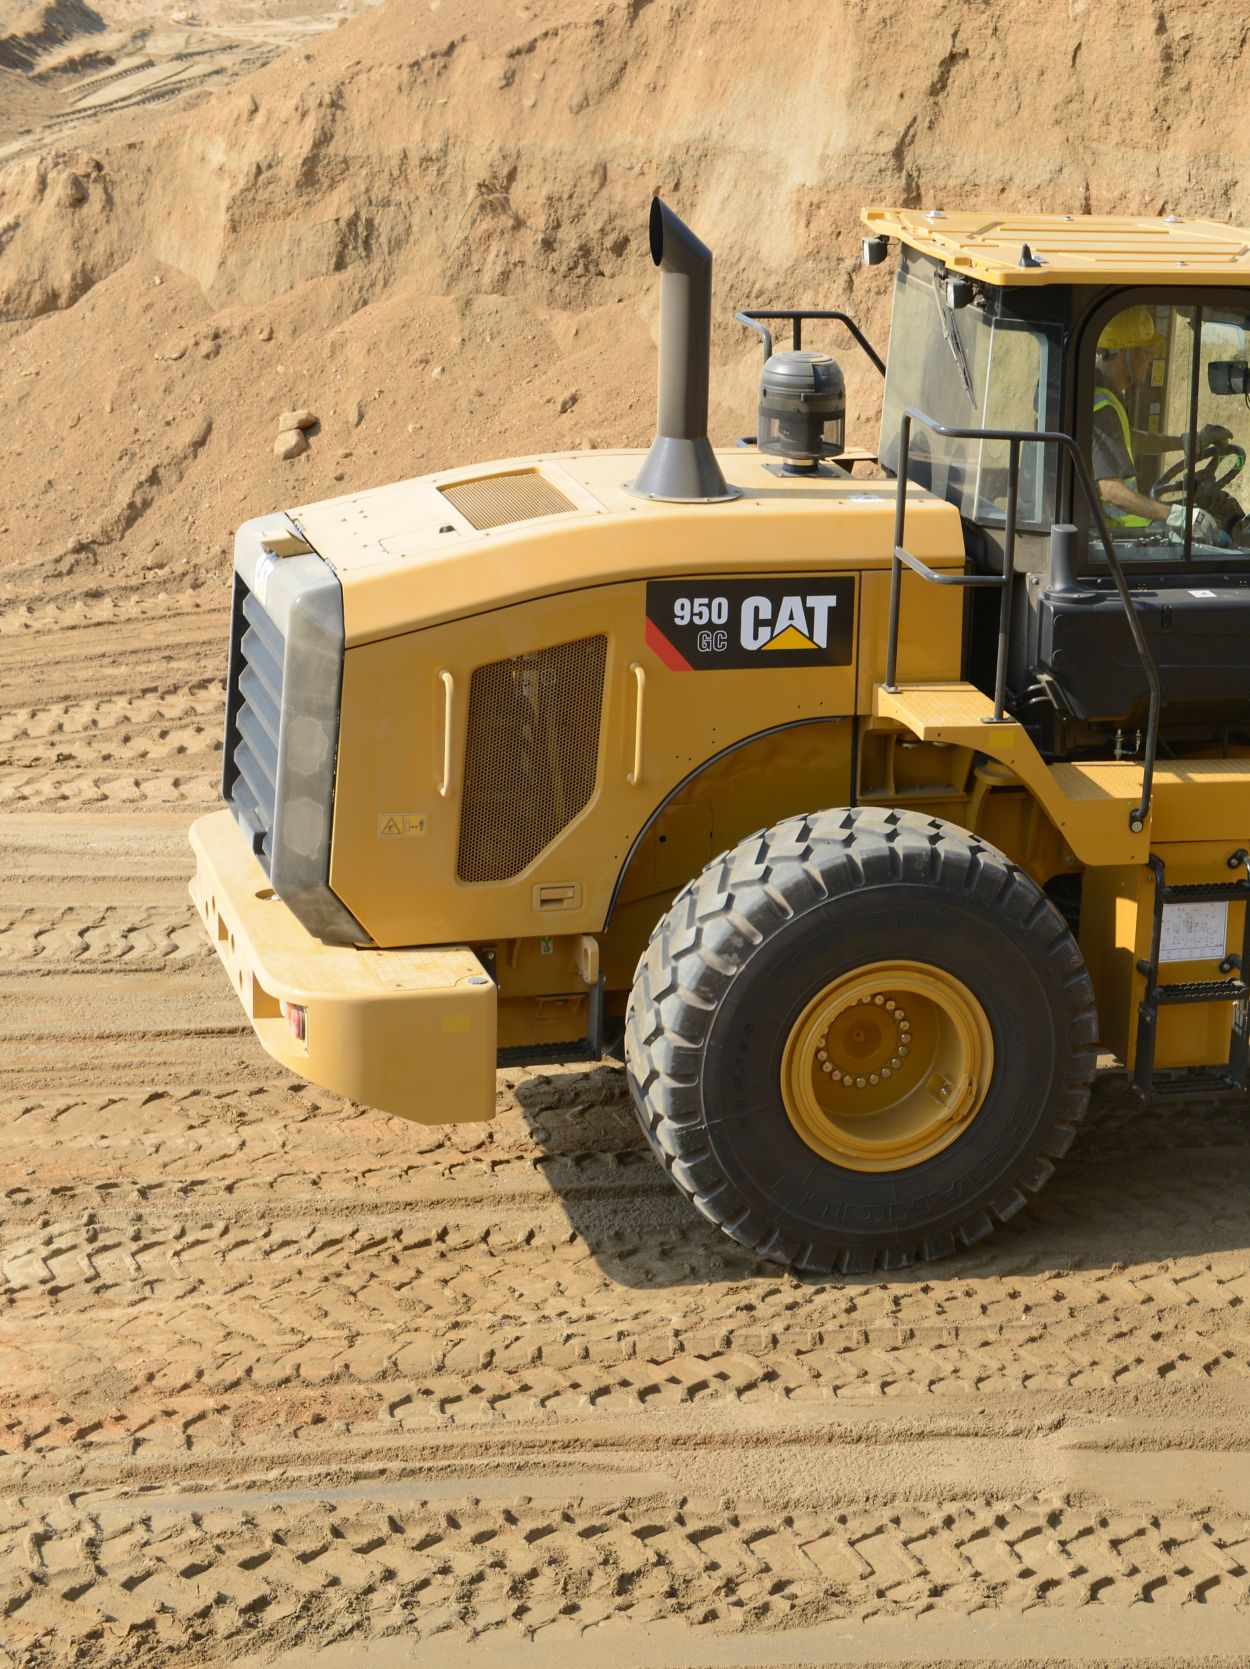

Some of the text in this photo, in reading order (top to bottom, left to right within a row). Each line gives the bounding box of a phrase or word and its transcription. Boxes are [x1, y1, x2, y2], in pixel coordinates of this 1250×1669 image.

[674, 597, 729, 626] 950
[740, 595, 837, 651] CAT
[697, 630, 728, 652] GC
